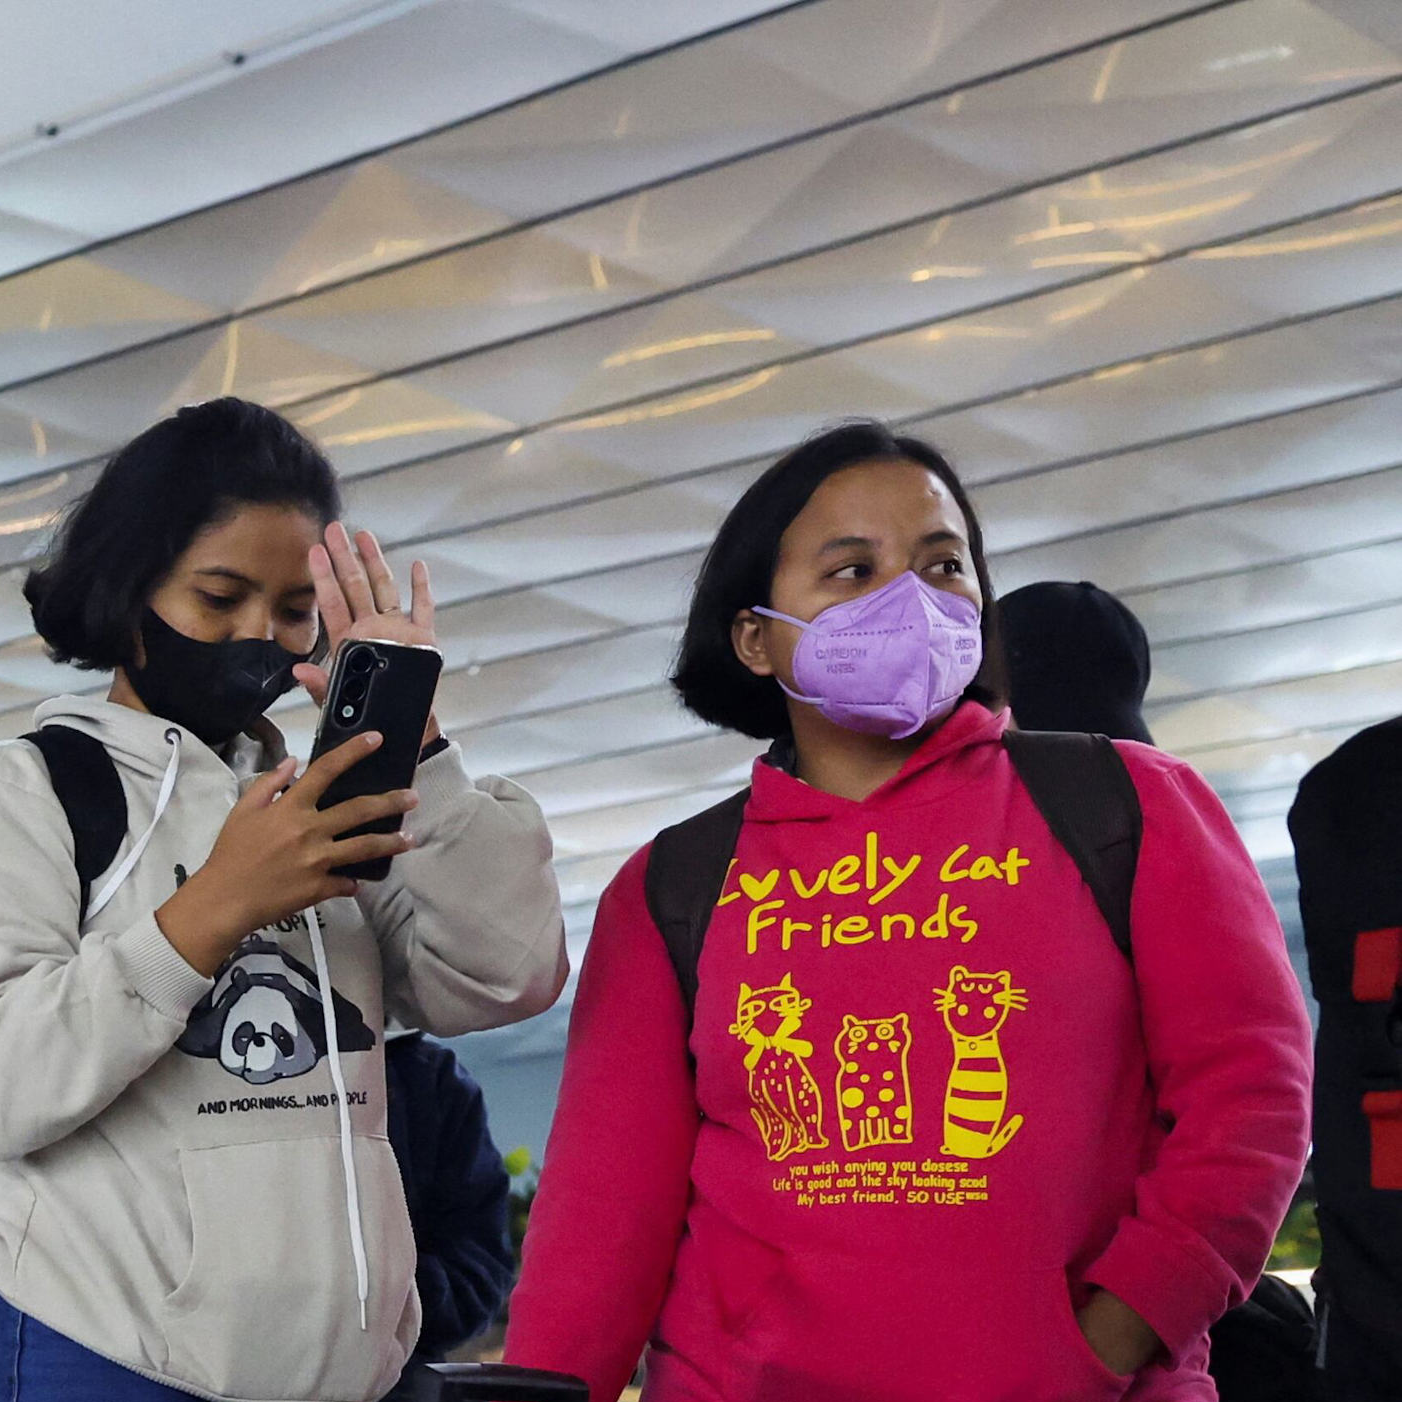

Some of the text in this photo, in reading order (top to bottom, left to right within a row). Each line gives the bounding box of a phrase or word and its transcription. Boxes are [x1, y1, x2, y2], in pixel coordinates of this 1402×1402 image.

[746, 893, 978, 954] Friends
[197, 1099, 227, 1115] AND
[331, 1091, 368, 1107] POPLE
[789, 1164, 808, 1180] you
[813, 1160, 839, 1175] wish
[892, 1161, 916, 1176] you
[794, 1177, 804, 1190] is
[807, 1175, 832, 1193] good
[836, 1175, 857, 1188] and
[862, 1175, 882, 1188] the
[887, 1174, 908, 1190] sky
[797, 1193, 815, 1208] My
[819, 1192, 847, 1205] best
